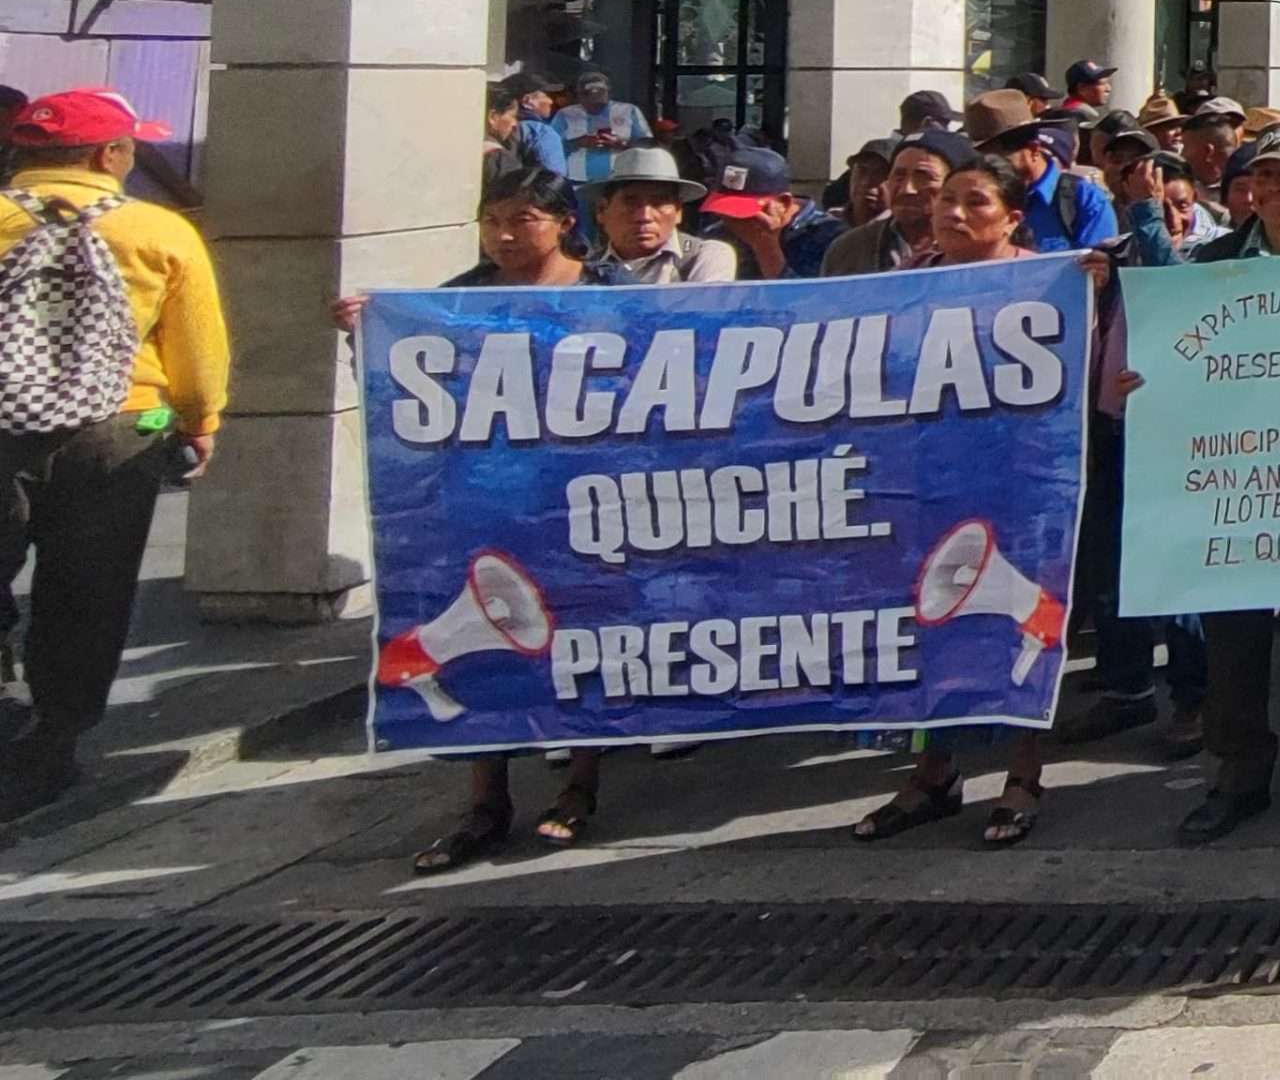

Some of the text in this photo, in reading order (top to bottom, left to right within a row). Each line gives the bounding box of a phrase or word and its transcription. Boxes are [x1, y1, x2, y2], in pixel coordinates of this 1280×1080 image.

[387, 300, 1064, 445] SACAPULAS
[565, 444, 892, 563] QUICHÉ.
[1185, 468, 1237, 493] SAN
[1204, 536, 1242, 567] EL
[551, 605, 918, 701] PRESENTE
